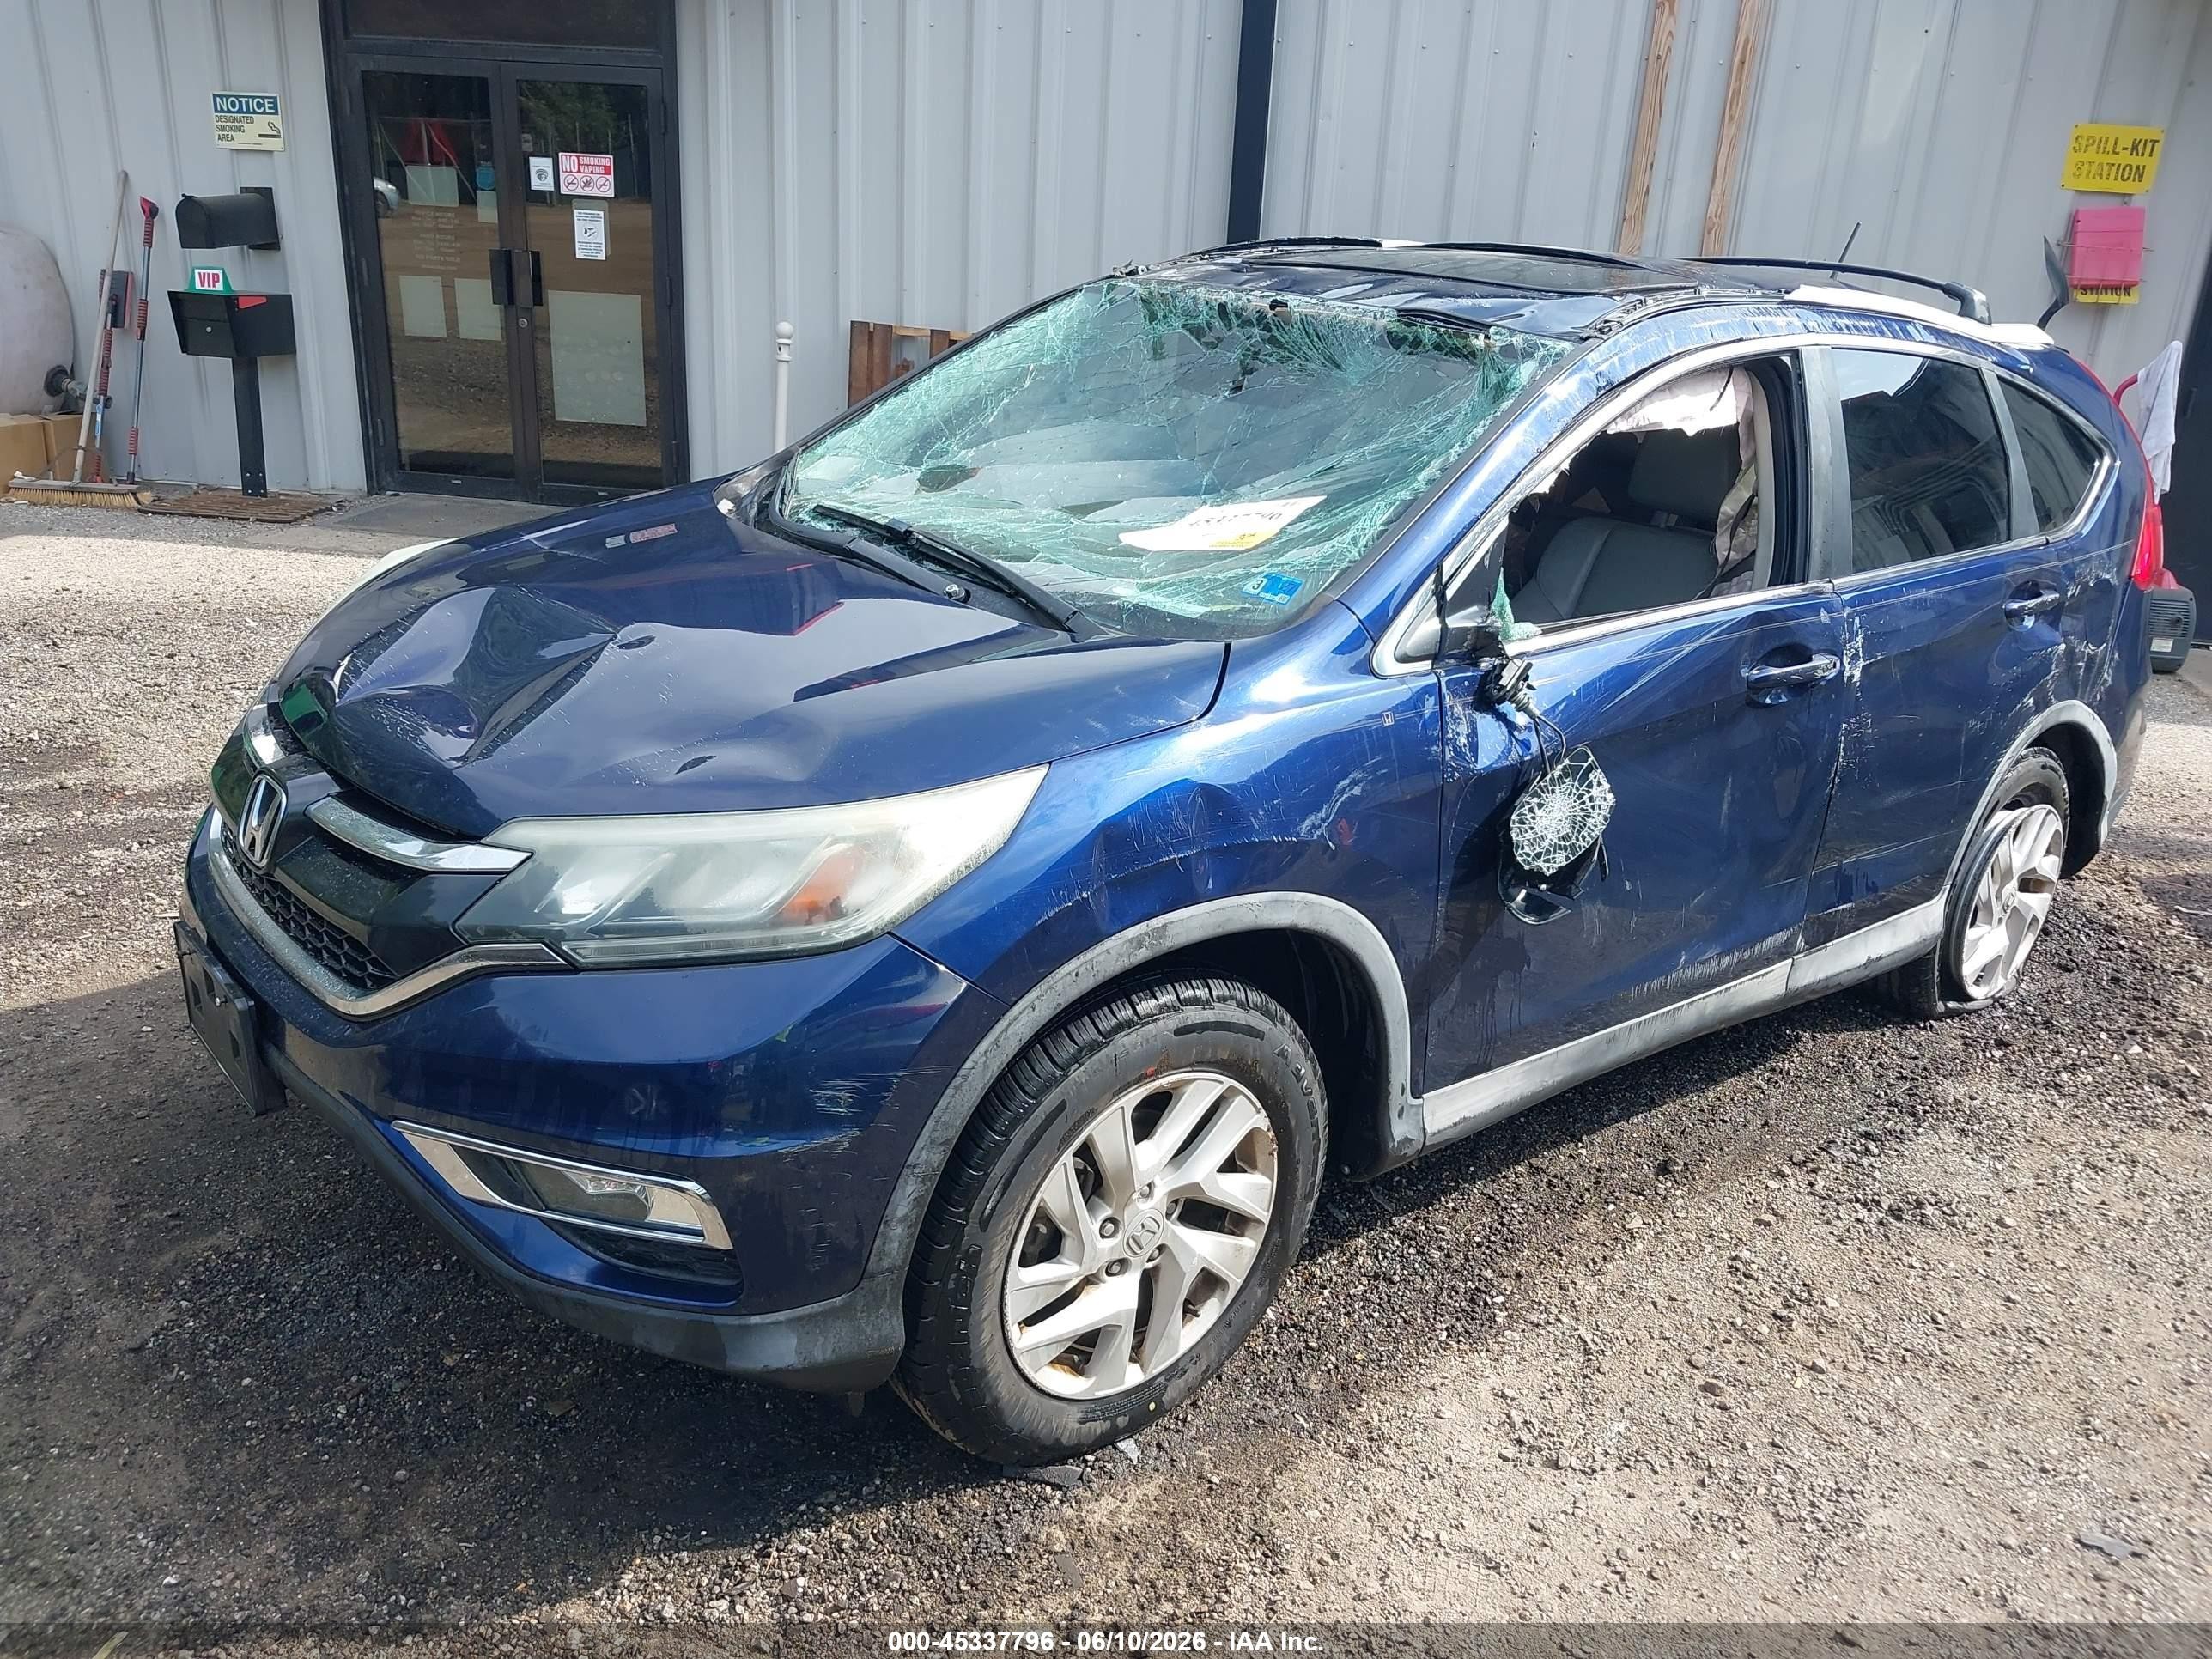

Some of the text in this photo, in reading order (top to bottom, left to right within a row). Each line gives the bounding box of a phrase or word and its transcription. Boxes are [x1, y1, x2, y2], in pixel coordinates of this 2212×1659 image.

[216, 97, 276, 112] NOTICE
[215, 115, 254, 124] DESIGNATED
[216, 125, 246, 133] SMOKING
[2073, 135, 2160, 157] SPILL-KIT
[562, 155, 611, 173] NO SMOKING
[580, 165, 605, 174] VAPING
[2072, 161, 2147, 183] STATION
[198, 271, 221, 289] VIP
